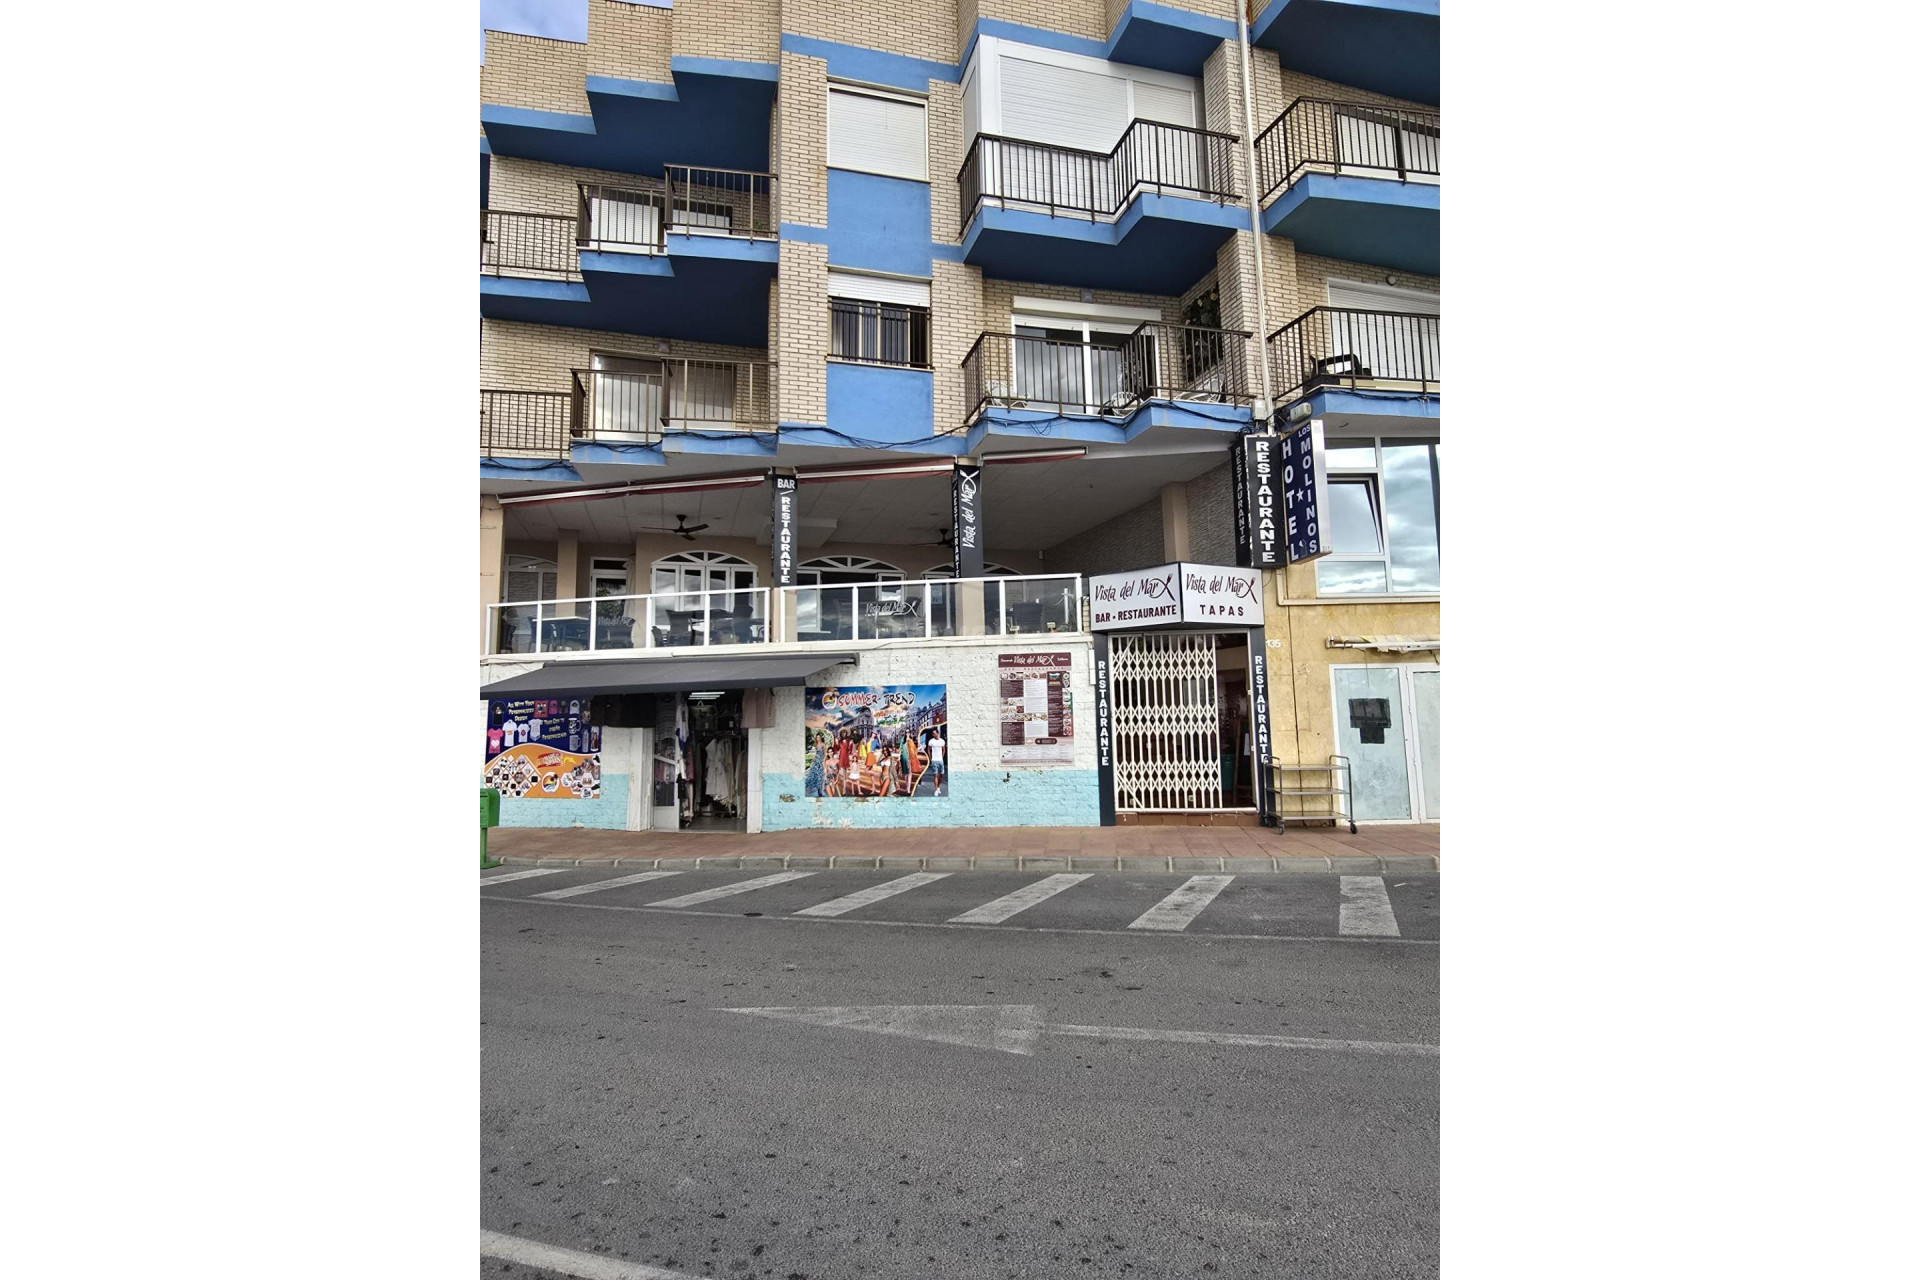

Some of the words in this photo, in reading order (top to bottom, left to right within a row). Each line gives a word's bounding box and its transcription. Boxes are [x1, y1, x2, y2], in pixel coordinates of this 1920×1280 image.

[1298, 424, 1311, 438] LOS
[777, 478, 796, 490] BAR
[960, 483, 974, 506] Mar
[1235, 446, 1246, 545] RESTAURANTE
[1300, 437, 1318, 554] MOLINOS
[1255, 440, 1276, 563] RESTAURANTE
[1282, 438, 1299, 561] HOTEL
[961, 506, 976, 523] del
[780, 496, 792, 584] RESTAURANTE
[962, 525, 976, 549] Vista
[1095, 585, 1117, 602] Vista
[1120, 580, 1136, 600] del
[1138, 578, 1159, 598] Mar
[1186, 573, 1207, 594] Vista
[1209, 575, 1224, 595] del
[1225, 576, 1244, 594] Mar
[1095, 610, 1111, 623] BAR
[1117, 604, 1177, 622] RESTAURANTE
[1199, 604, 1245, 617] TAPAS
[883, 691, 916, 705] TREND
[1254, 655, 1270, 764] RESTAURANTE
[1097, 660, 1109, 767] RESTAURANTE
